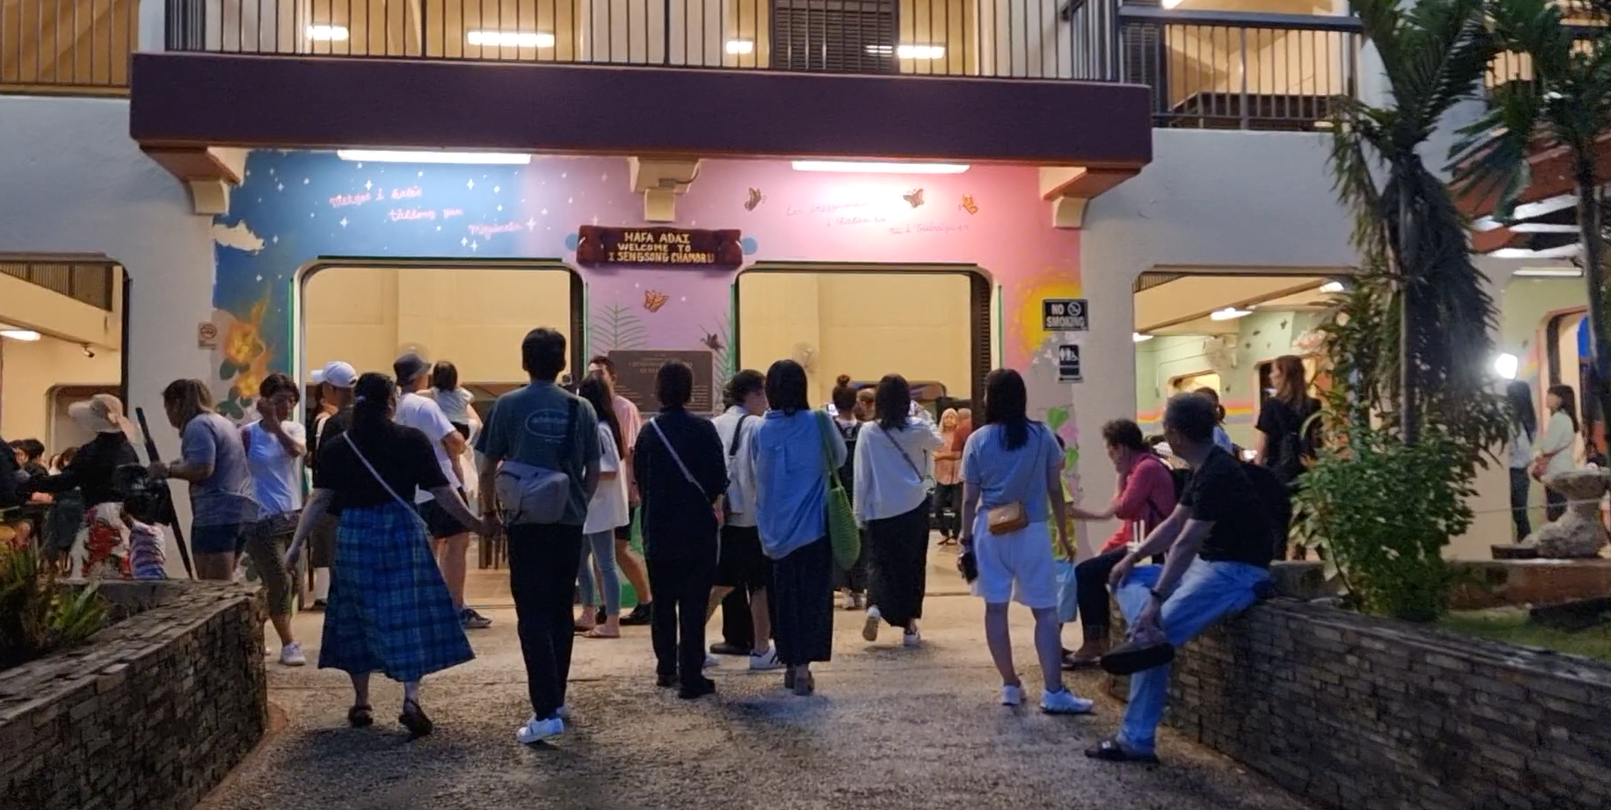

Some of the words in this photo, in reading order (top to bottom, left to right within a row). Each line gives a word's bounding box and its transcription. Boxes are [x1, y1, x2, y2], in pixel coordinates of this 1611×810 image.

[624, 232, 654, 243] HAFA
[660, 233, 690, 243] ADAI
[617, 243, 668, 252] WELCOME
[677, 244, 691, 252] TO
[608, 253, 614, 261] I
[617, 252, 669, 262] SENGSONG
[671, 253, 715, 263] CHAMORU
[1051, 304, 1064, 315] NO
[1046, 316, 1085, 327] SMOKING
